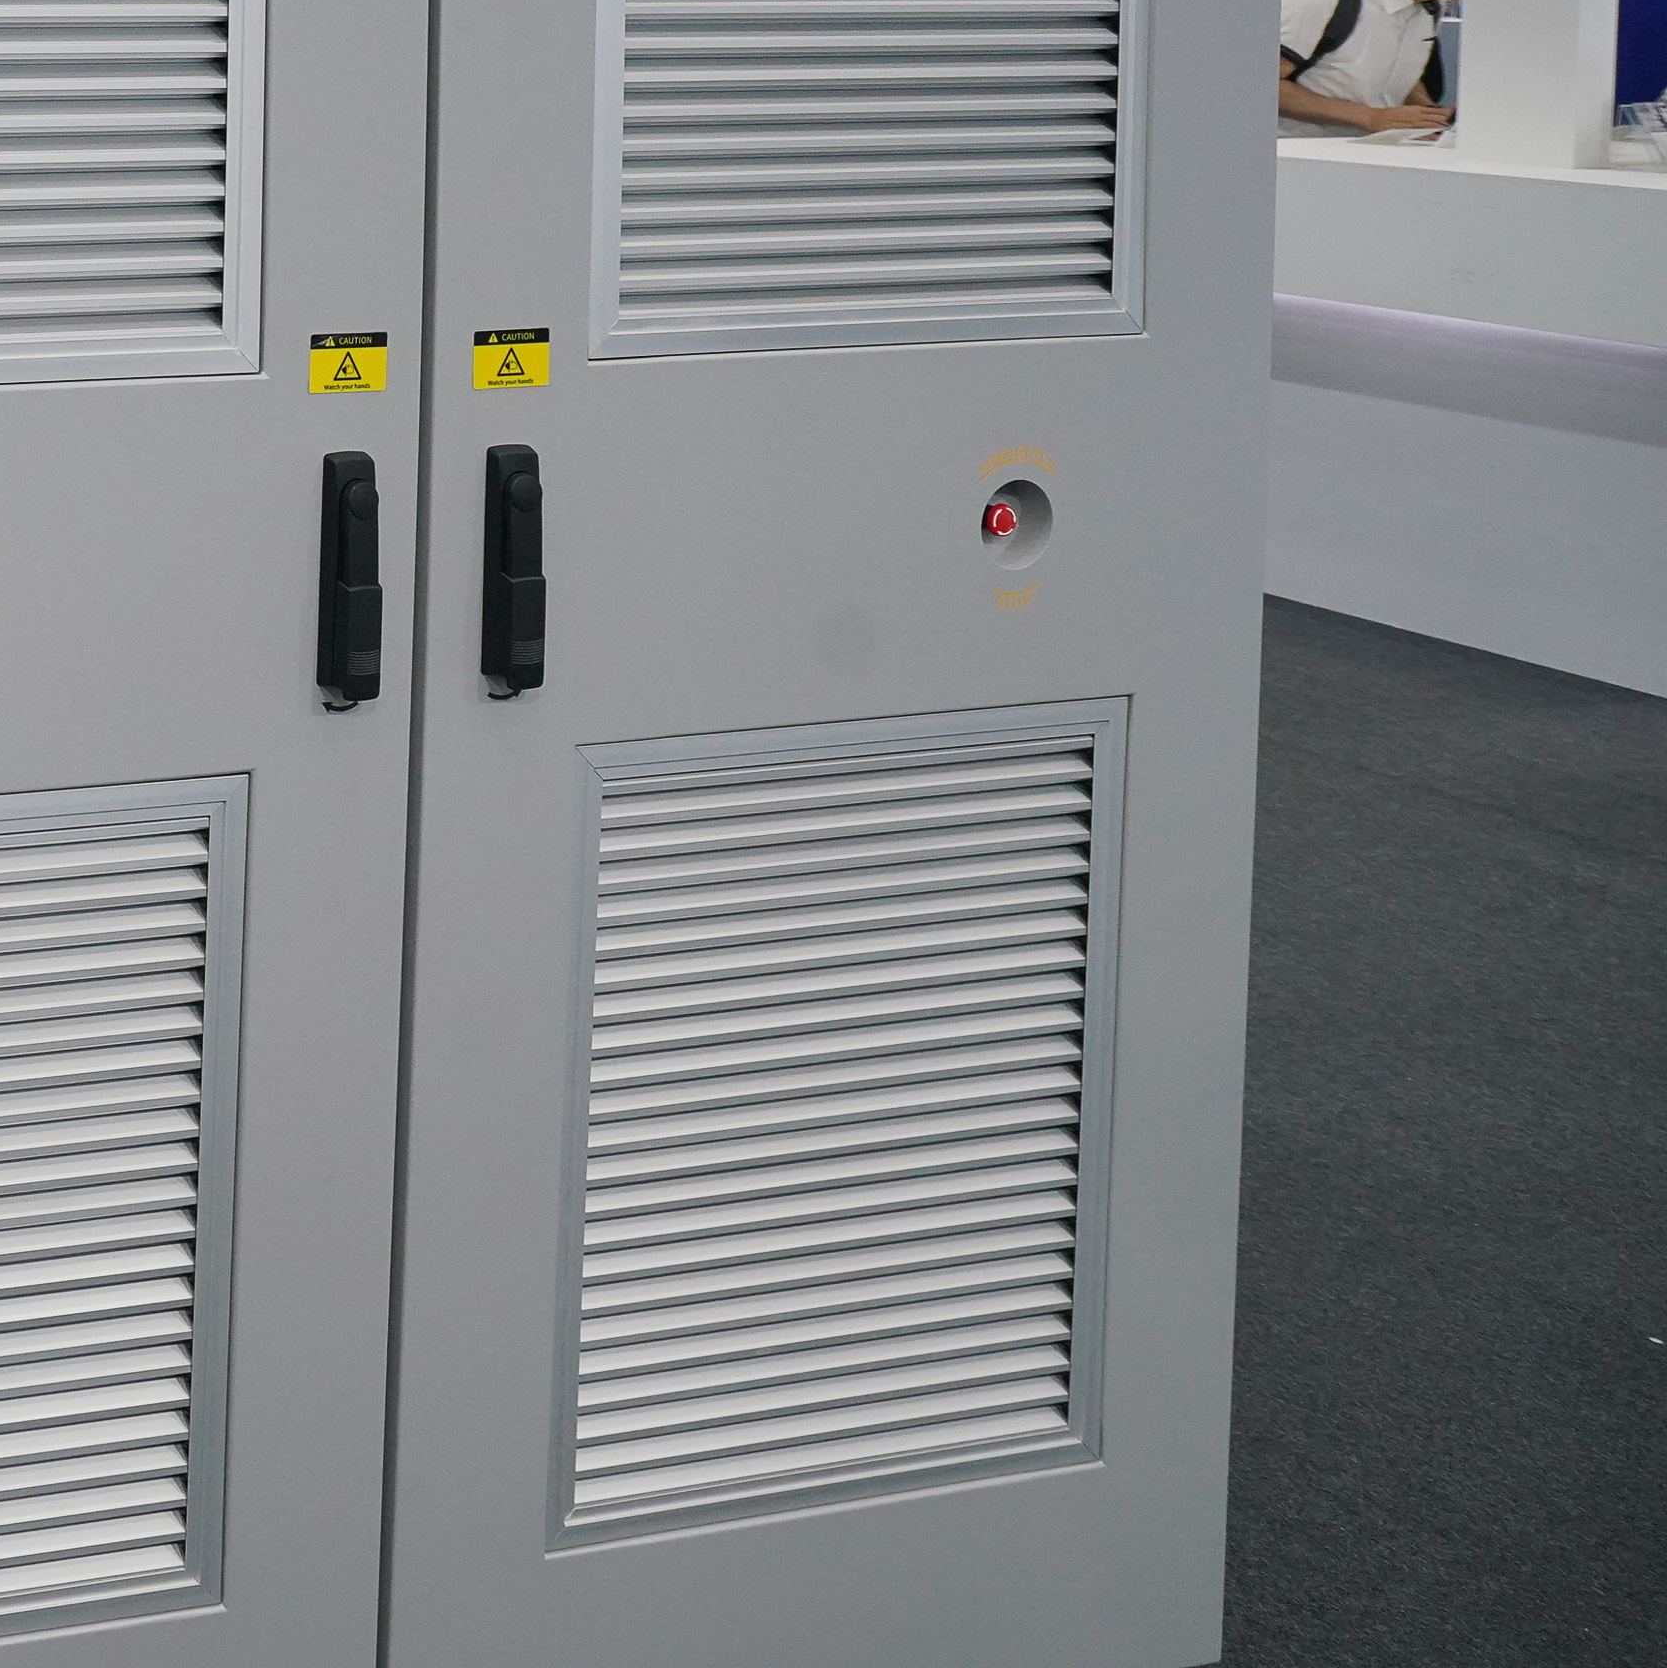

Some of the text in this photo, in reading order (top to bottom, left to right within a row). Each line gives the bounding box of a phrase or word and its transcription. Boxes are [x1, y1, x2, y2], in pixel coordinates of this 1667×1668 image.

[339, 335, 372, 345] CAUTION
[502, 332, 535, 342] CAUTION
[354, 382, 371, 390] hands
[979, 445, 1057, 473] EMERGENCY
[995, 594, 1034, 611] STOP
